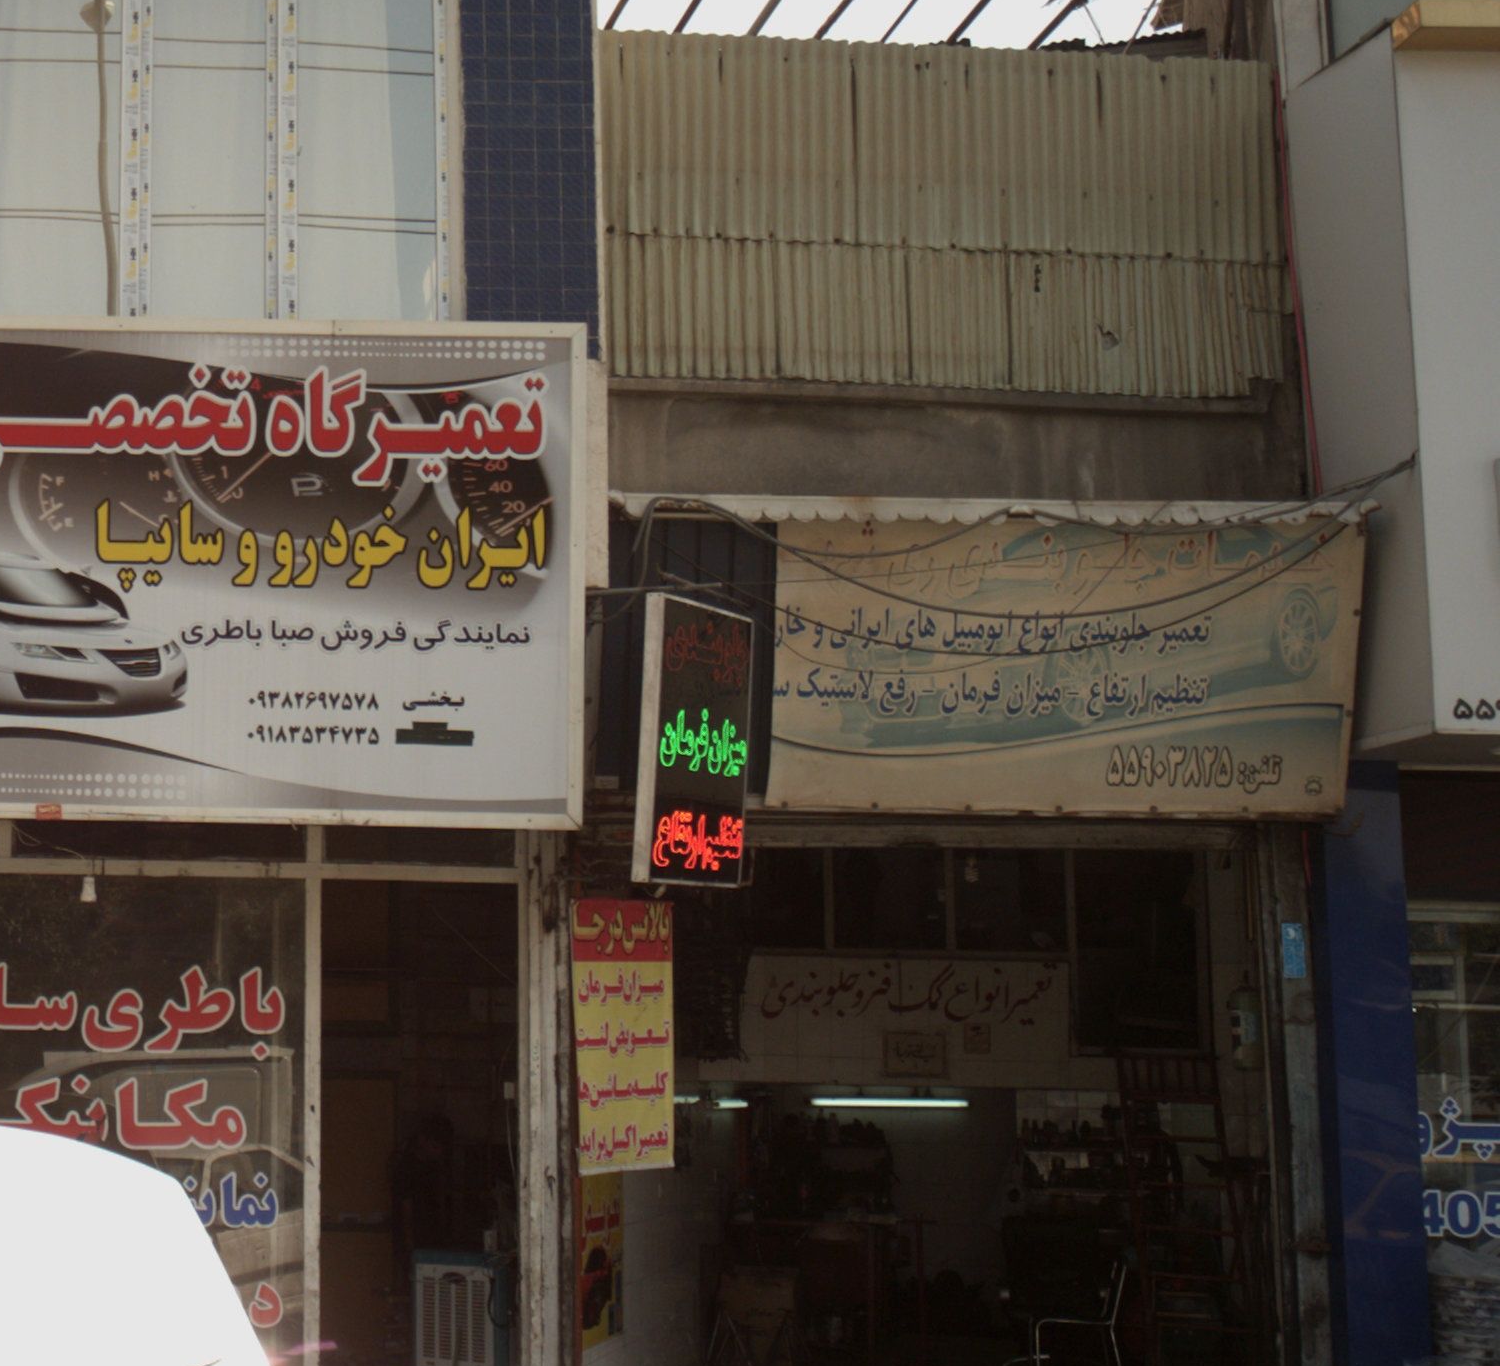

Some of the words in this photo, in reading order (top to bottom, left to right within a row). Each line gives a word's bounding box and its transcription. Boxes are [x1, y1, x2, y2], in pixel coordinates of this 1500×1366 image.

[266, 365, 550, 487] تعمیرگاه
[94, 500, 226, 592] سایپا
[232, 521, 261, 587] و
[270, 505, 408, 590] خودرو
[417, 505, 548, 589] ایران
[181, 619, 264, 648] باطری
[271, 620, 315, 646] صبا
[321, 619, 407, 651] فروش
[812, 621, 824, 648] و
[830, 607, 889, 649] ایرانی
[896, 610, 936, 650] های
[1018, 611, 1065, 655] انواع
[1069, 612, 1151, 654] جلوبندی
[1157, 615, 1212, 654] تعمیر
[403, 691, 465, 711] بخشی
[796, 668, 874, 707] لاستیک
[880, 670, 915, 714] رفع
[941, 670, 1001, 714] فرمان
[1006, 673, 1061, 715] میزان
[1085, 673, 1147, 717] ارتفاع
[1152, 673, 1209, 715] تنظیم
[660, 708, 710, 772] فرمان
[707, 718, 748, 777] میزان
[1105, 744, 1234, 787] ۵۵۹۰۳۸۲۵
[82, 965, 286, 1061] باطری
[1001, 962, 1057, 1025] تعمیر
